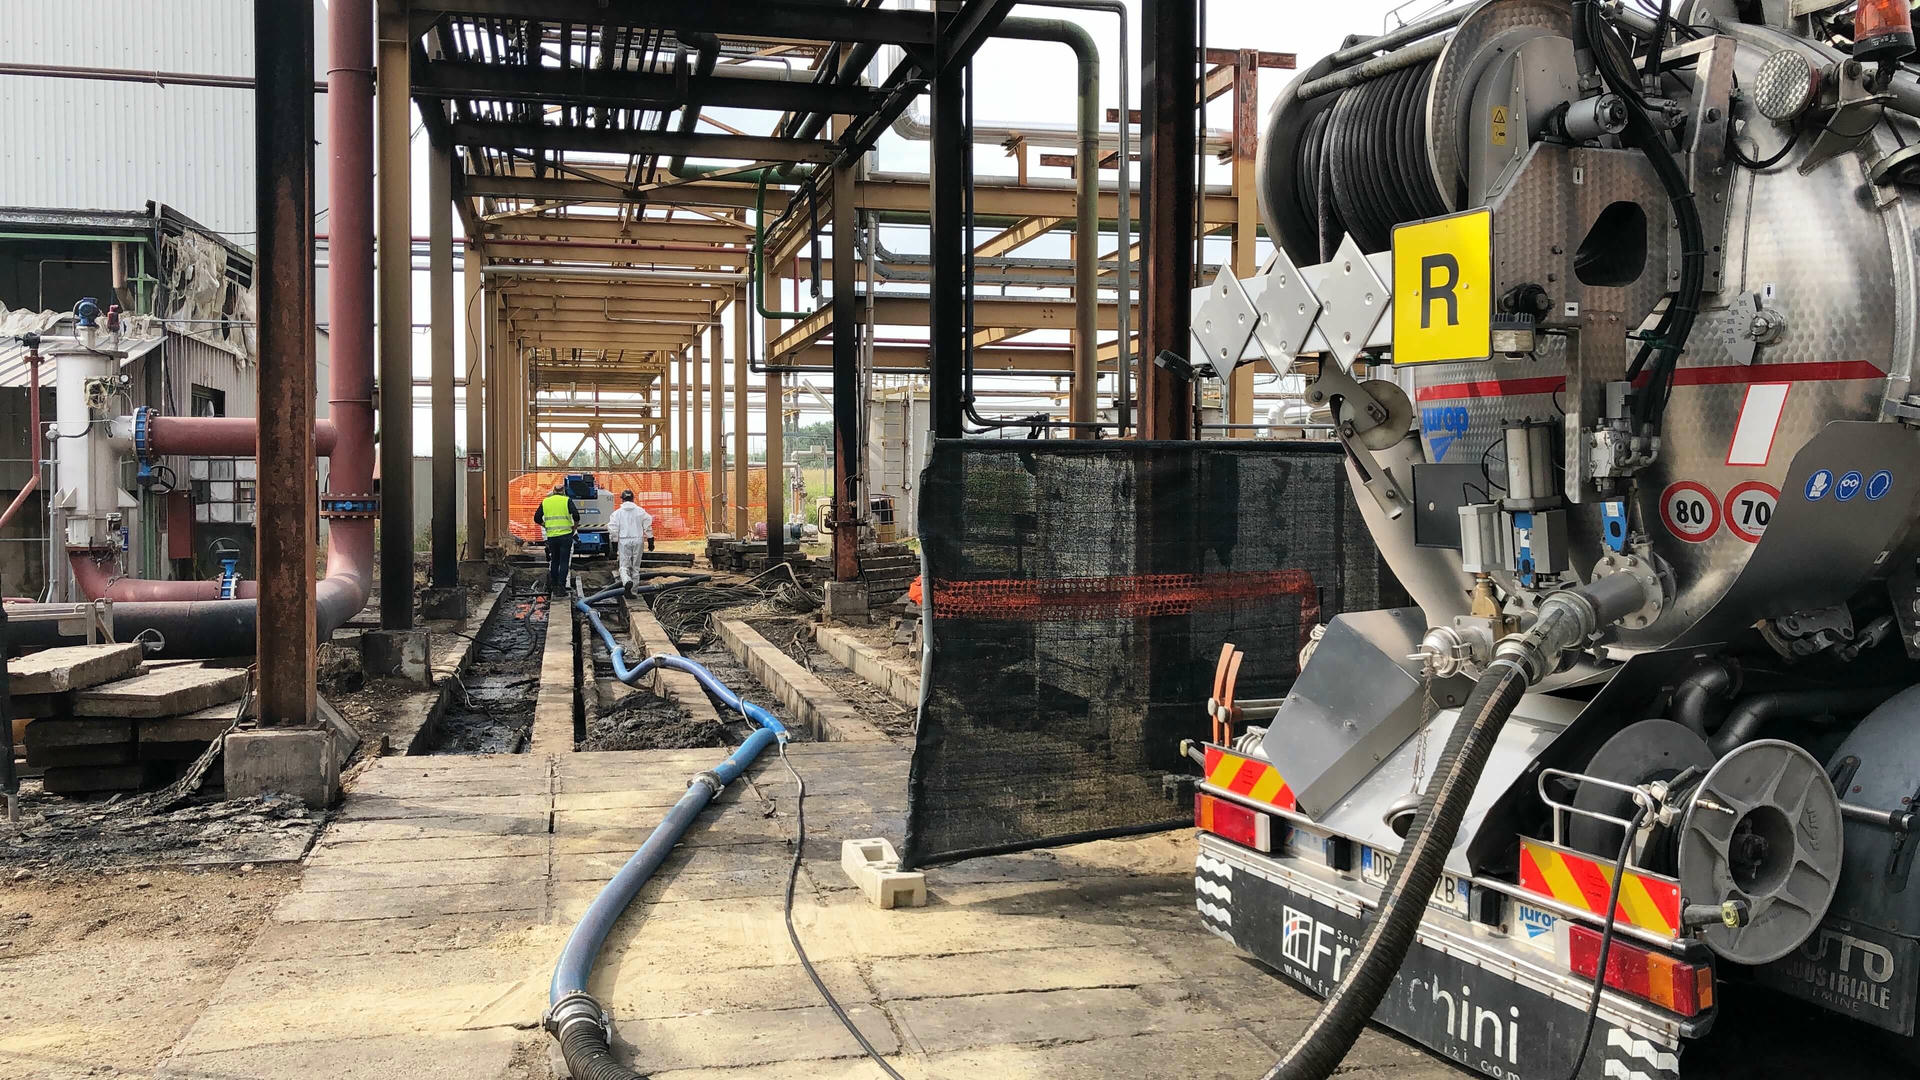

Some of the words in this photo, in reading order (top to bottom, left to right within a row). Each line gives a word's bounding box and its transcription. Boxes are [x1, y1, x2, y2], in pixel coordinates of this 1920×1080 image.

[1421, 253, 1459, 329] R
[1676, 500, 1705, 524] 80
[1741, 500, 1771, 526] 70
